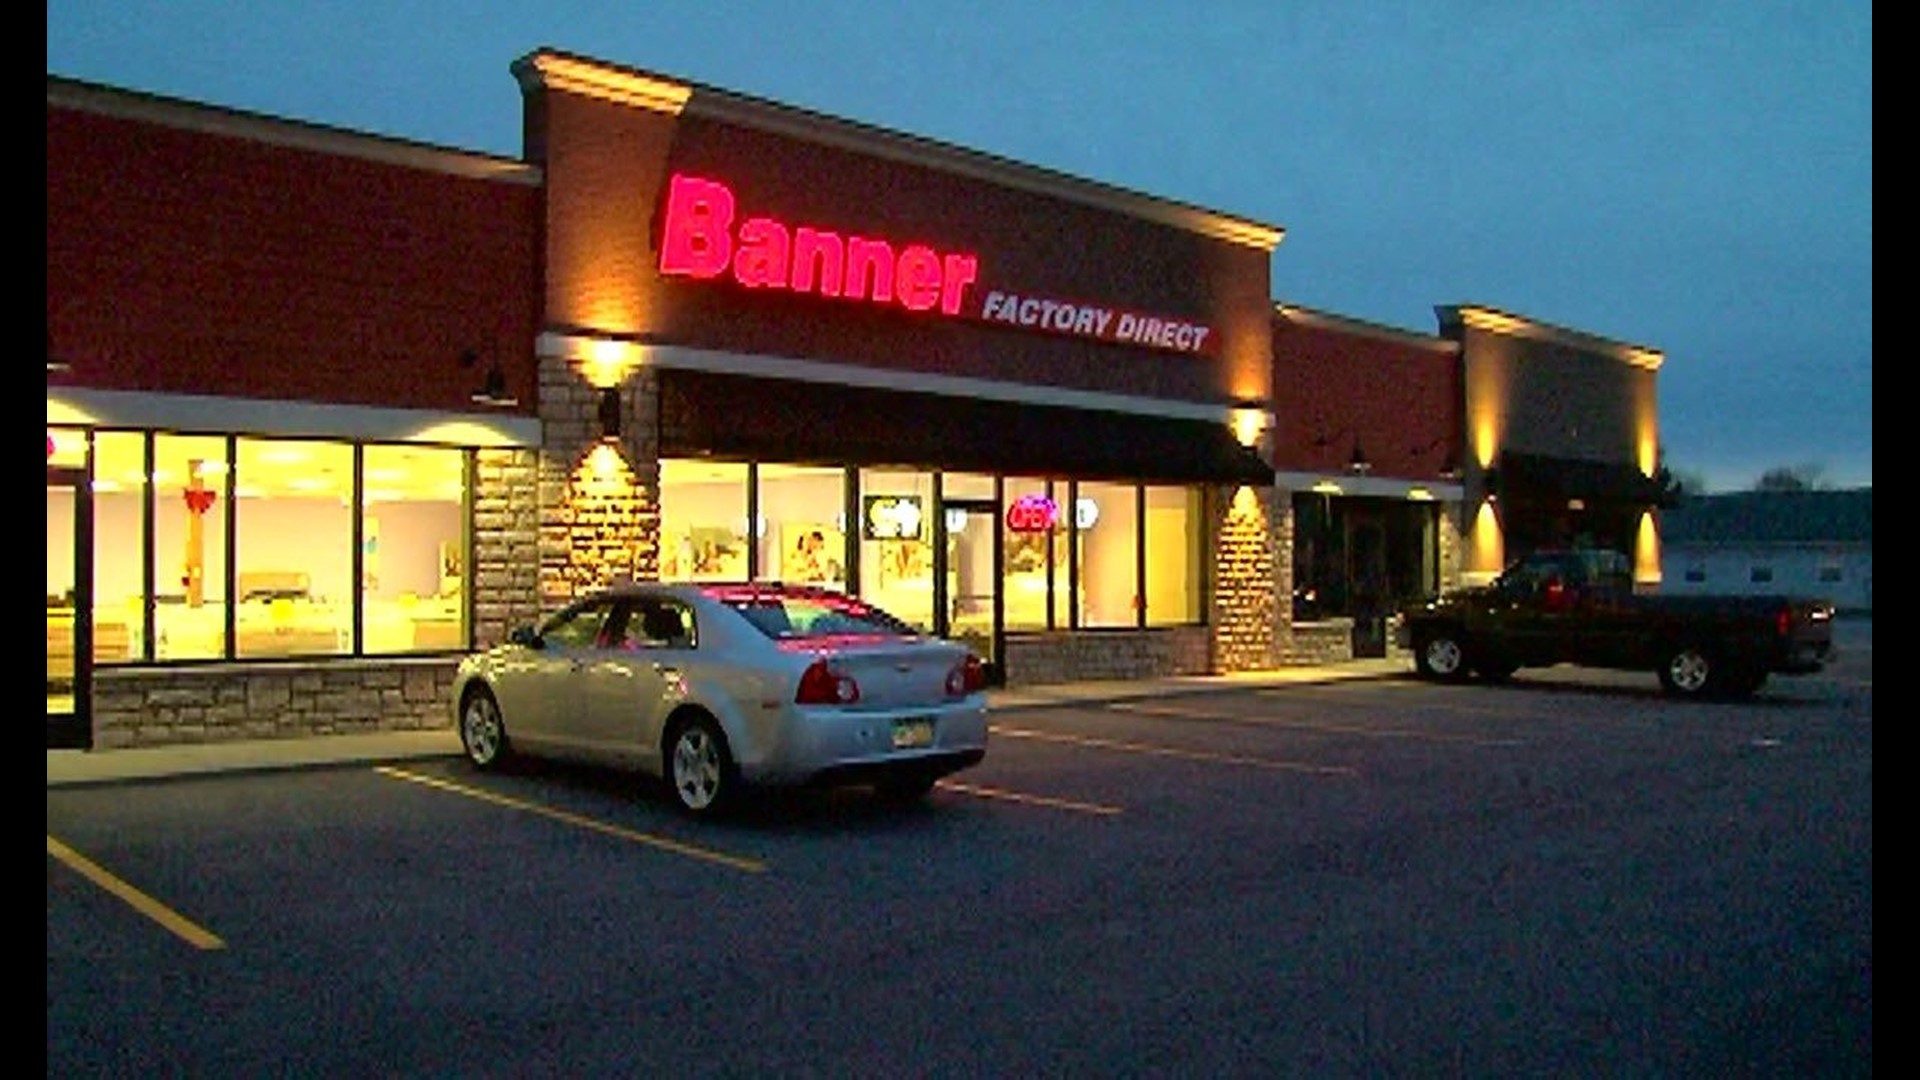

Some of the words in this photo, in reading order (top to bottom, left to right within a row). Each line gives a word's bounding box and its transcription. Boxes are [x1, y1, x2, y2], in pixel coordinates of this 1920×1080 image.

[660, 173, 977, 315] Banner
[982, 291, 1112, 335] FACTORY
[1116, 313, 1209, 351] DIRECT
